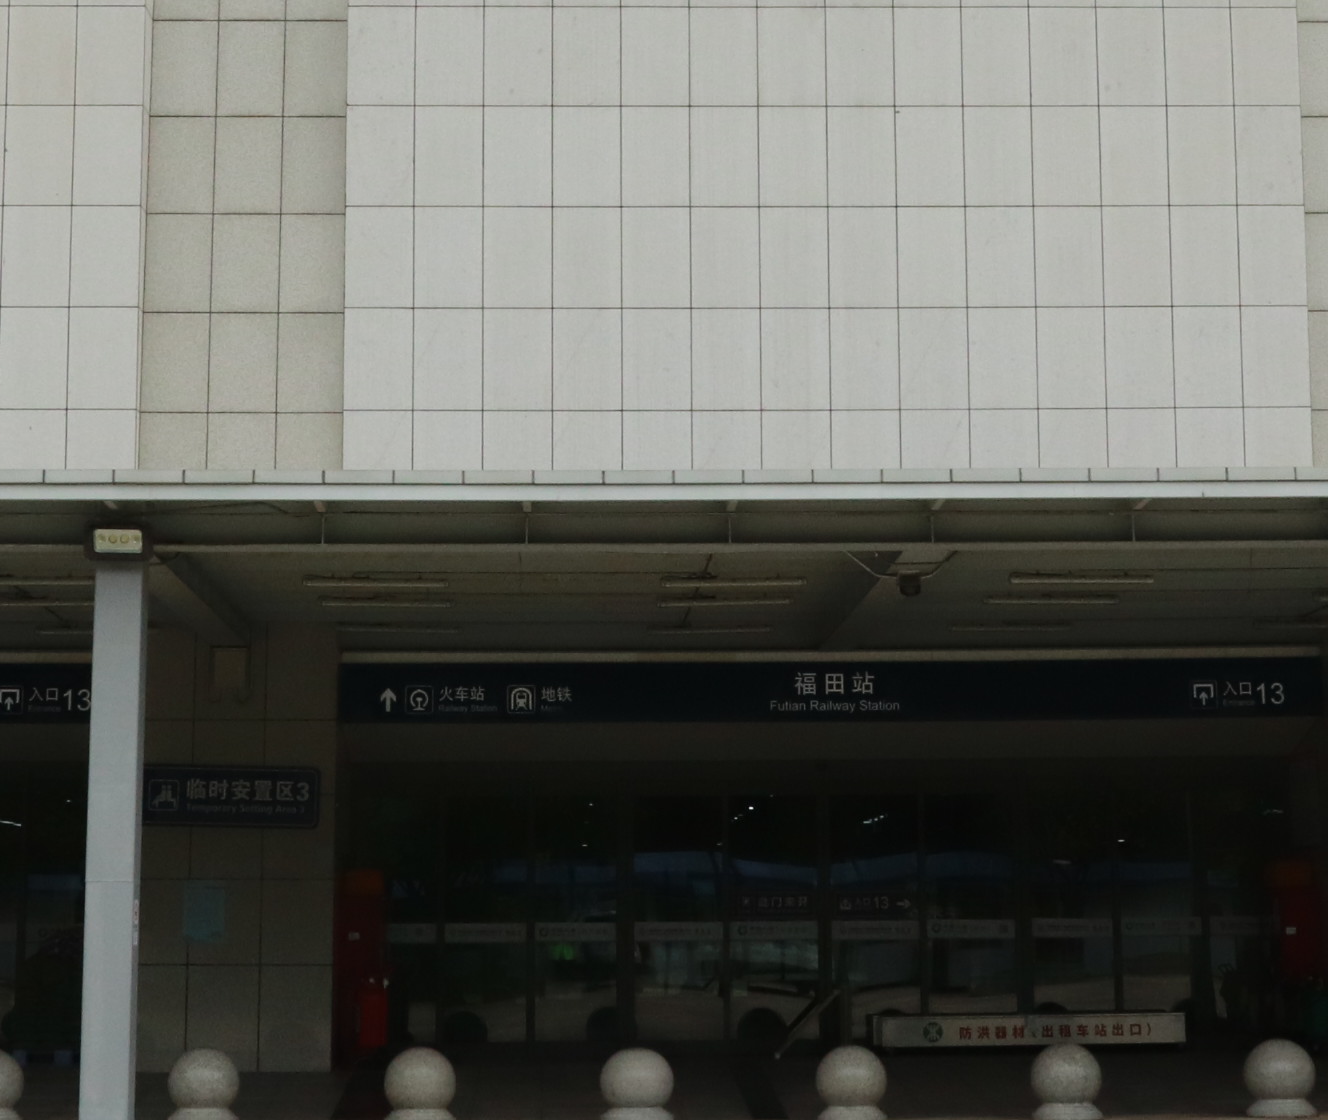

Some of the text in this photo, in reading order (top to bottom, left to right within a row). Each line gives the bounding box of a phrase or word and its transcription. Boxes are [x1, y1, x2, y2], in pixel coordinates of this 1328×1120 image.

[438, 685, 486, 703] 火车站
[541, 685, 573, 703] 地铁
[794, 670, 875, 696] 福田站
[1223, 680, 1285, 705] 入口 13
[29, 687, 91, 712] 入口 13
[769, 699, 900, 714] Futian Railway Station
[186, 778, 310, 801] 临时安置区3
